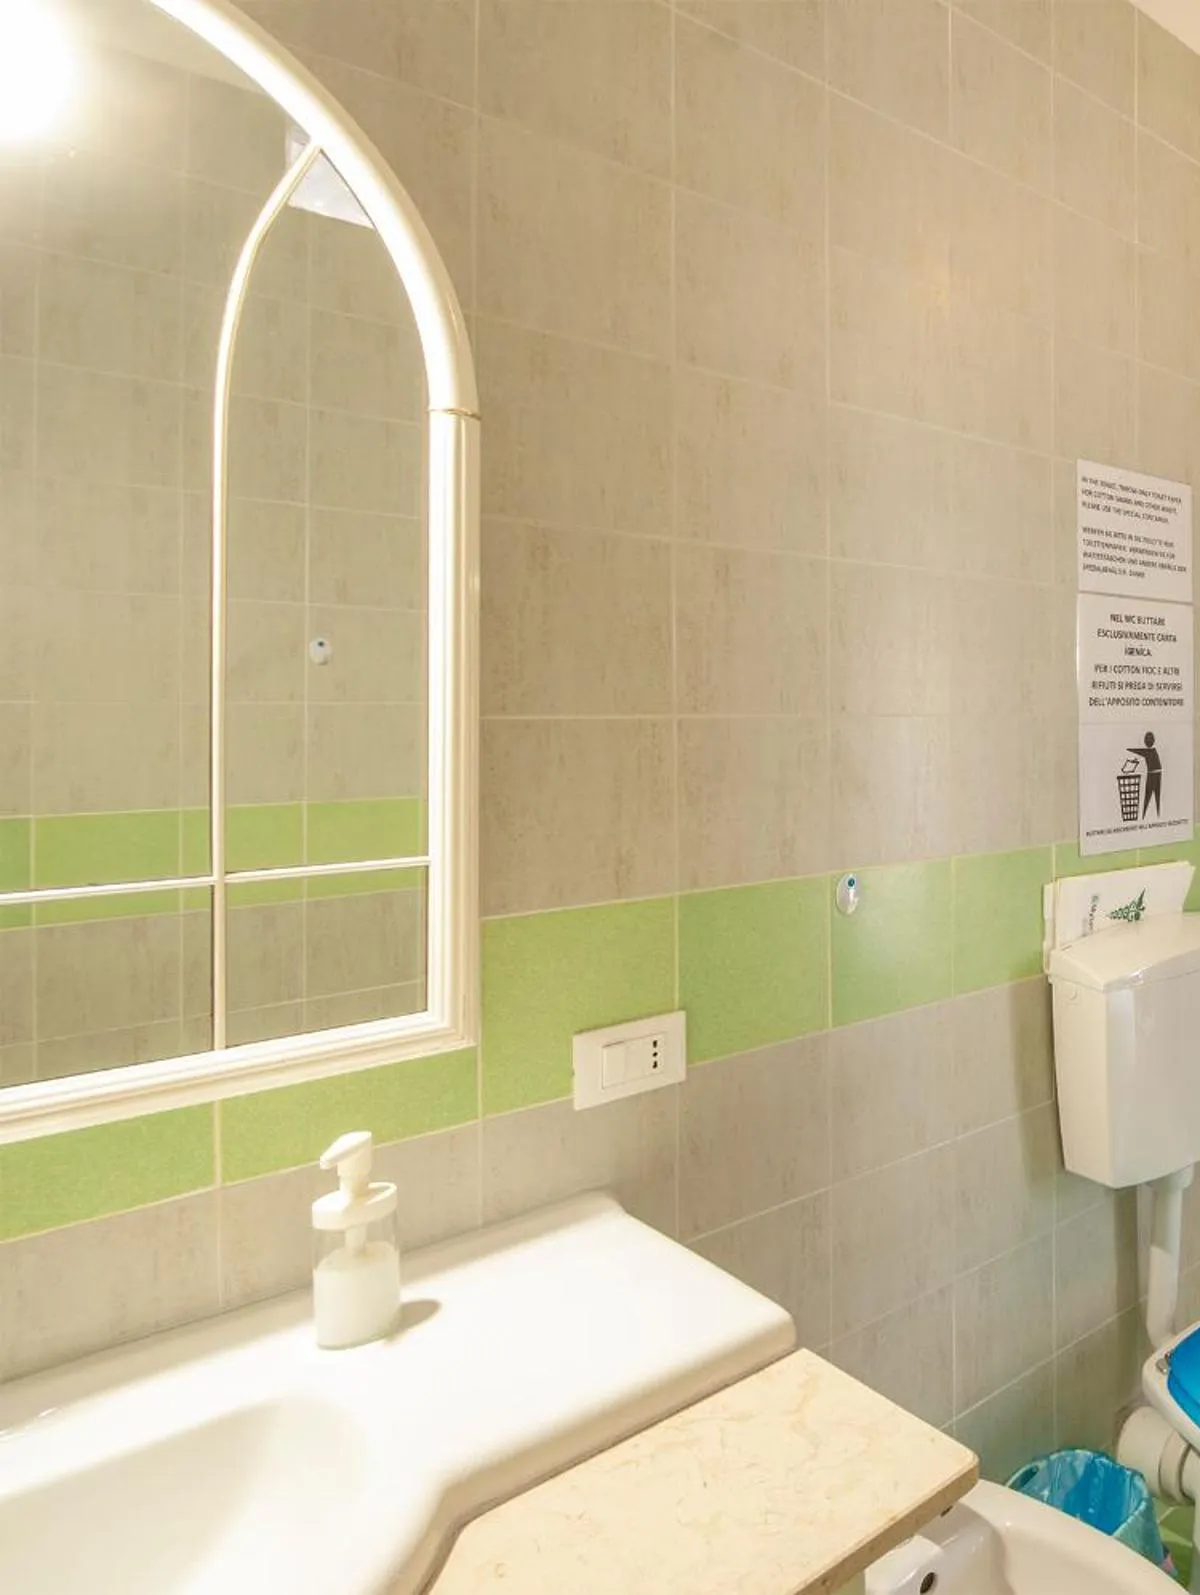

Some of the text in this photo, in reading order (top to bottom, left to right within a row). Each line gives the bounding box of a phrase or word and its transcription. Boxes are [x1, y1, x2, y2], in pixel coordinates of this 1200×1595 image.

[1110, 614, 1123, 623] NEL
[1137, 616, 1165, 626] BUTTARE
[1097, 628, 1156, 642] ESCLUSIVAMENTE
[1113, 665, 1140, 674] COTTON
